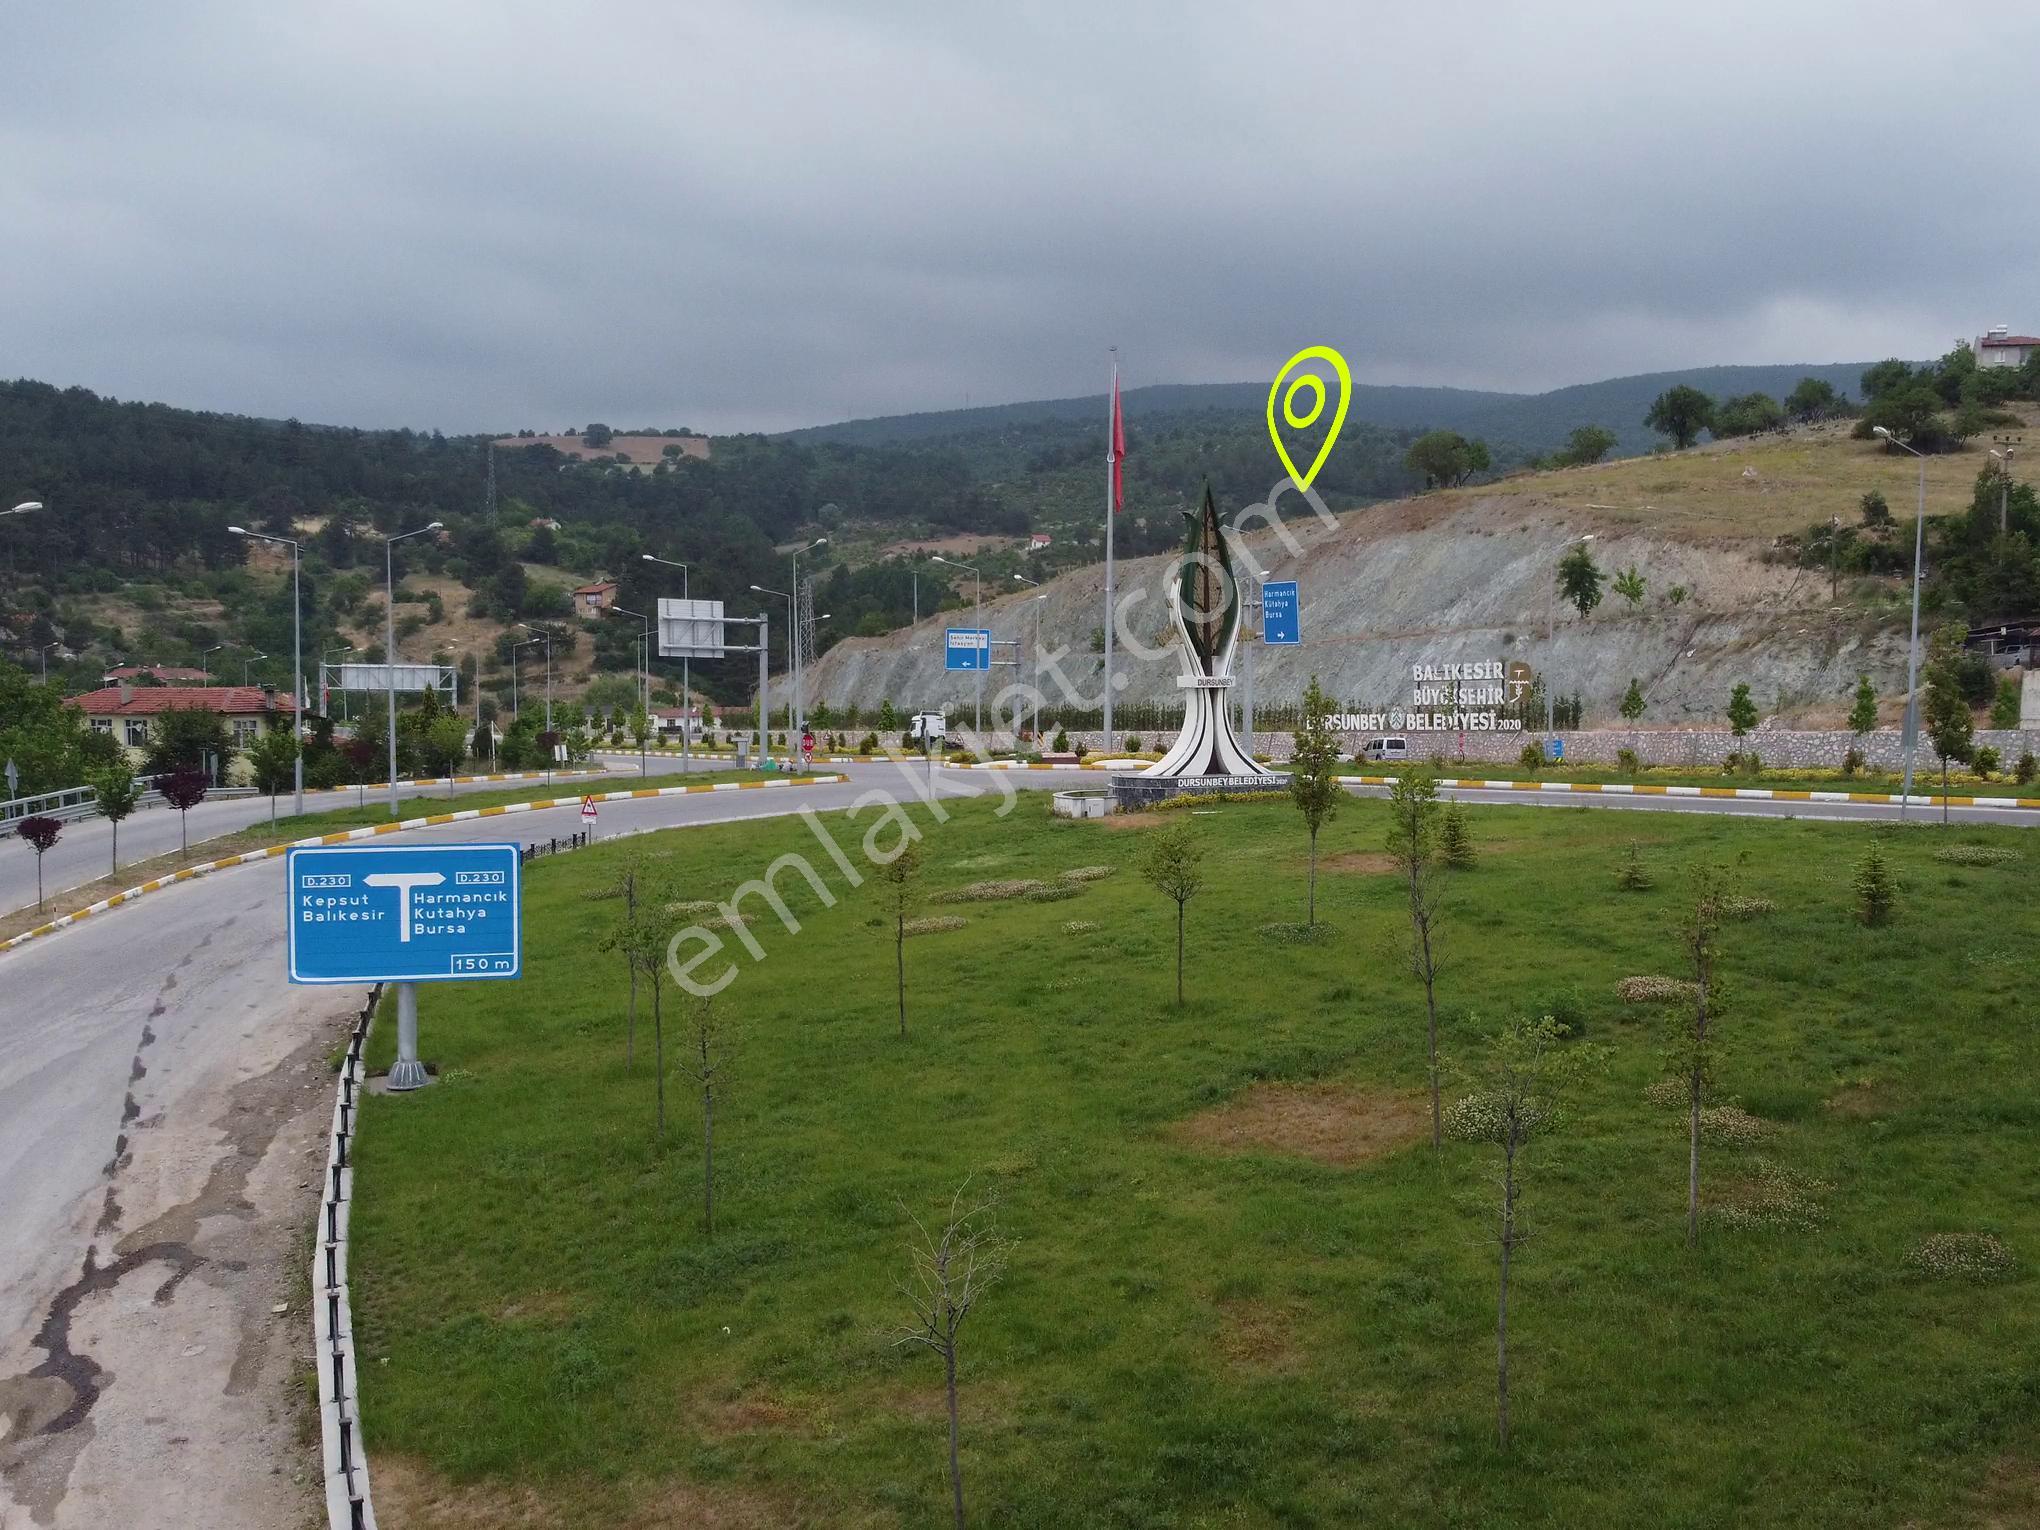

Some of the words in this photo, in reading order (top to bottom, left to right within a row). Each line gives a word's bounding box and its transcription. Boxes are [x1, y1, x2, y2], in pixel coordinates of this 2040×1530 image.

[1413, 659, 1504, 681] BALIKESİR
[1307, 714, 1387, 731] DRSUNBEY
[1406, 709, 1497, 731] BELEDİYESİ
[1498, 719, 1522, 731] 2020
[1178, 778, 1229, 787] DURSUNBEY
[307, 877, 346, 886] D.230
[460, 873, 500, 883] D.230
[303, 894, 369, 909] Kepsut
[415, 891, 507, 904] Harmancık
[303, 909, 385, 922] Balıkesir
[415, 907, 486, 920] Kutahya
[415, 923, 466, 935] Bursa
[456, 958, 489, 970] 150
[495, 959, 510, 970] m
